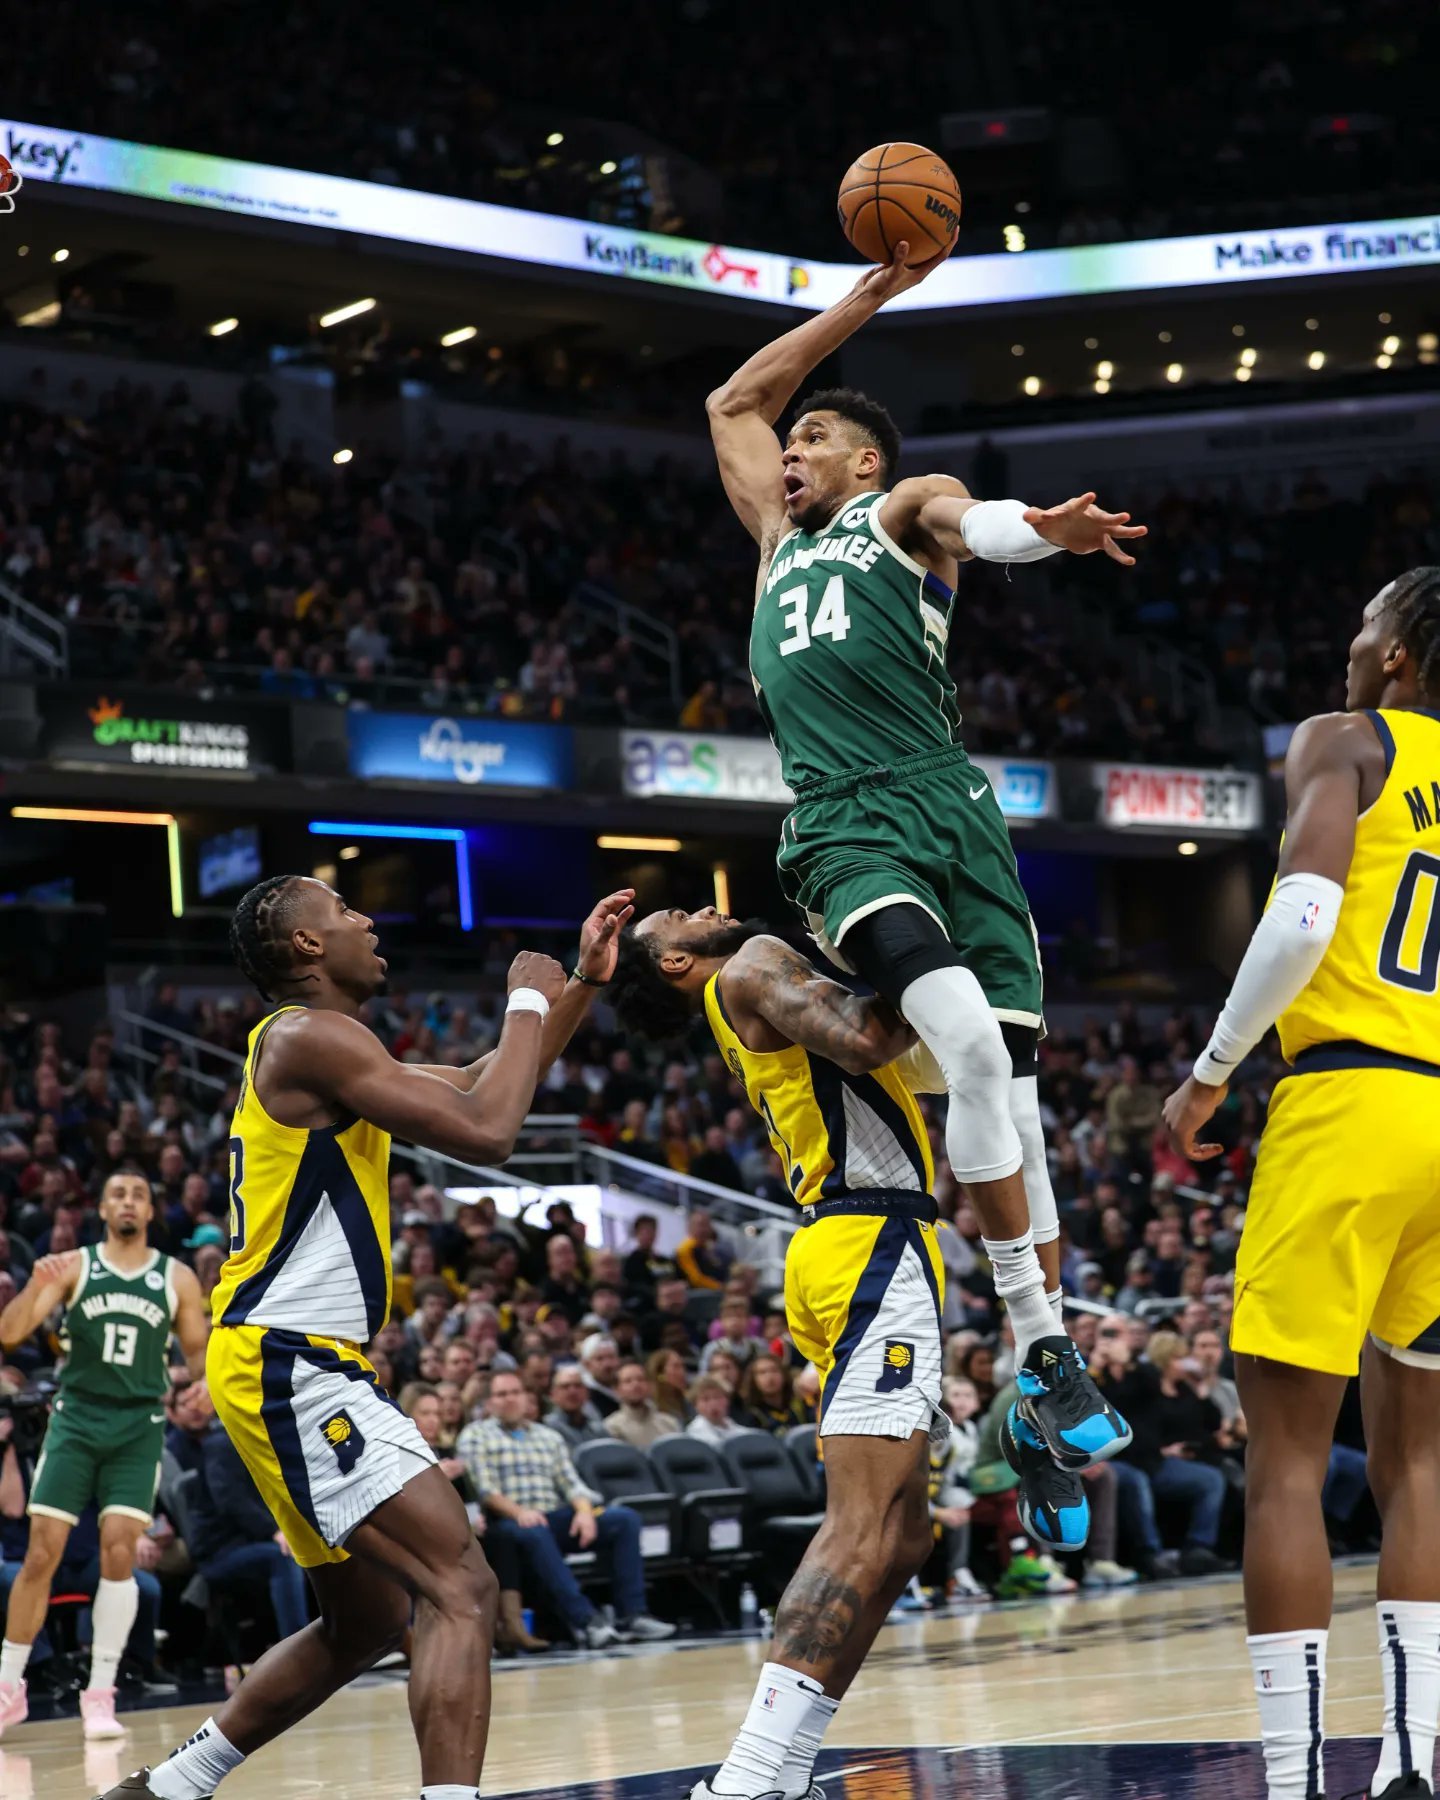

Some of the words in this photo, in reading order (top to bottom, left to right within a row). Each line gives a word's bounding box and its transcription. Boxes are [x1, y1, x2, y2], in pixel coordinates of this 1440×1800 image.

[583, 233, 695, 277] KeyBank
[1215, 238, 1311, 270] Make
[778, 574, 851, 656] 34
[131, 741, 248, 769] SPORTSBOOK
[419, 718, 507, 785] Kroger
[628, 736, 720, 793] aes
[1107, 768, 1248, 820] POINTSBET
[80, 1292, 166, 1329] MILWAUKEE
[102, 1322, 138, 1367] 13
